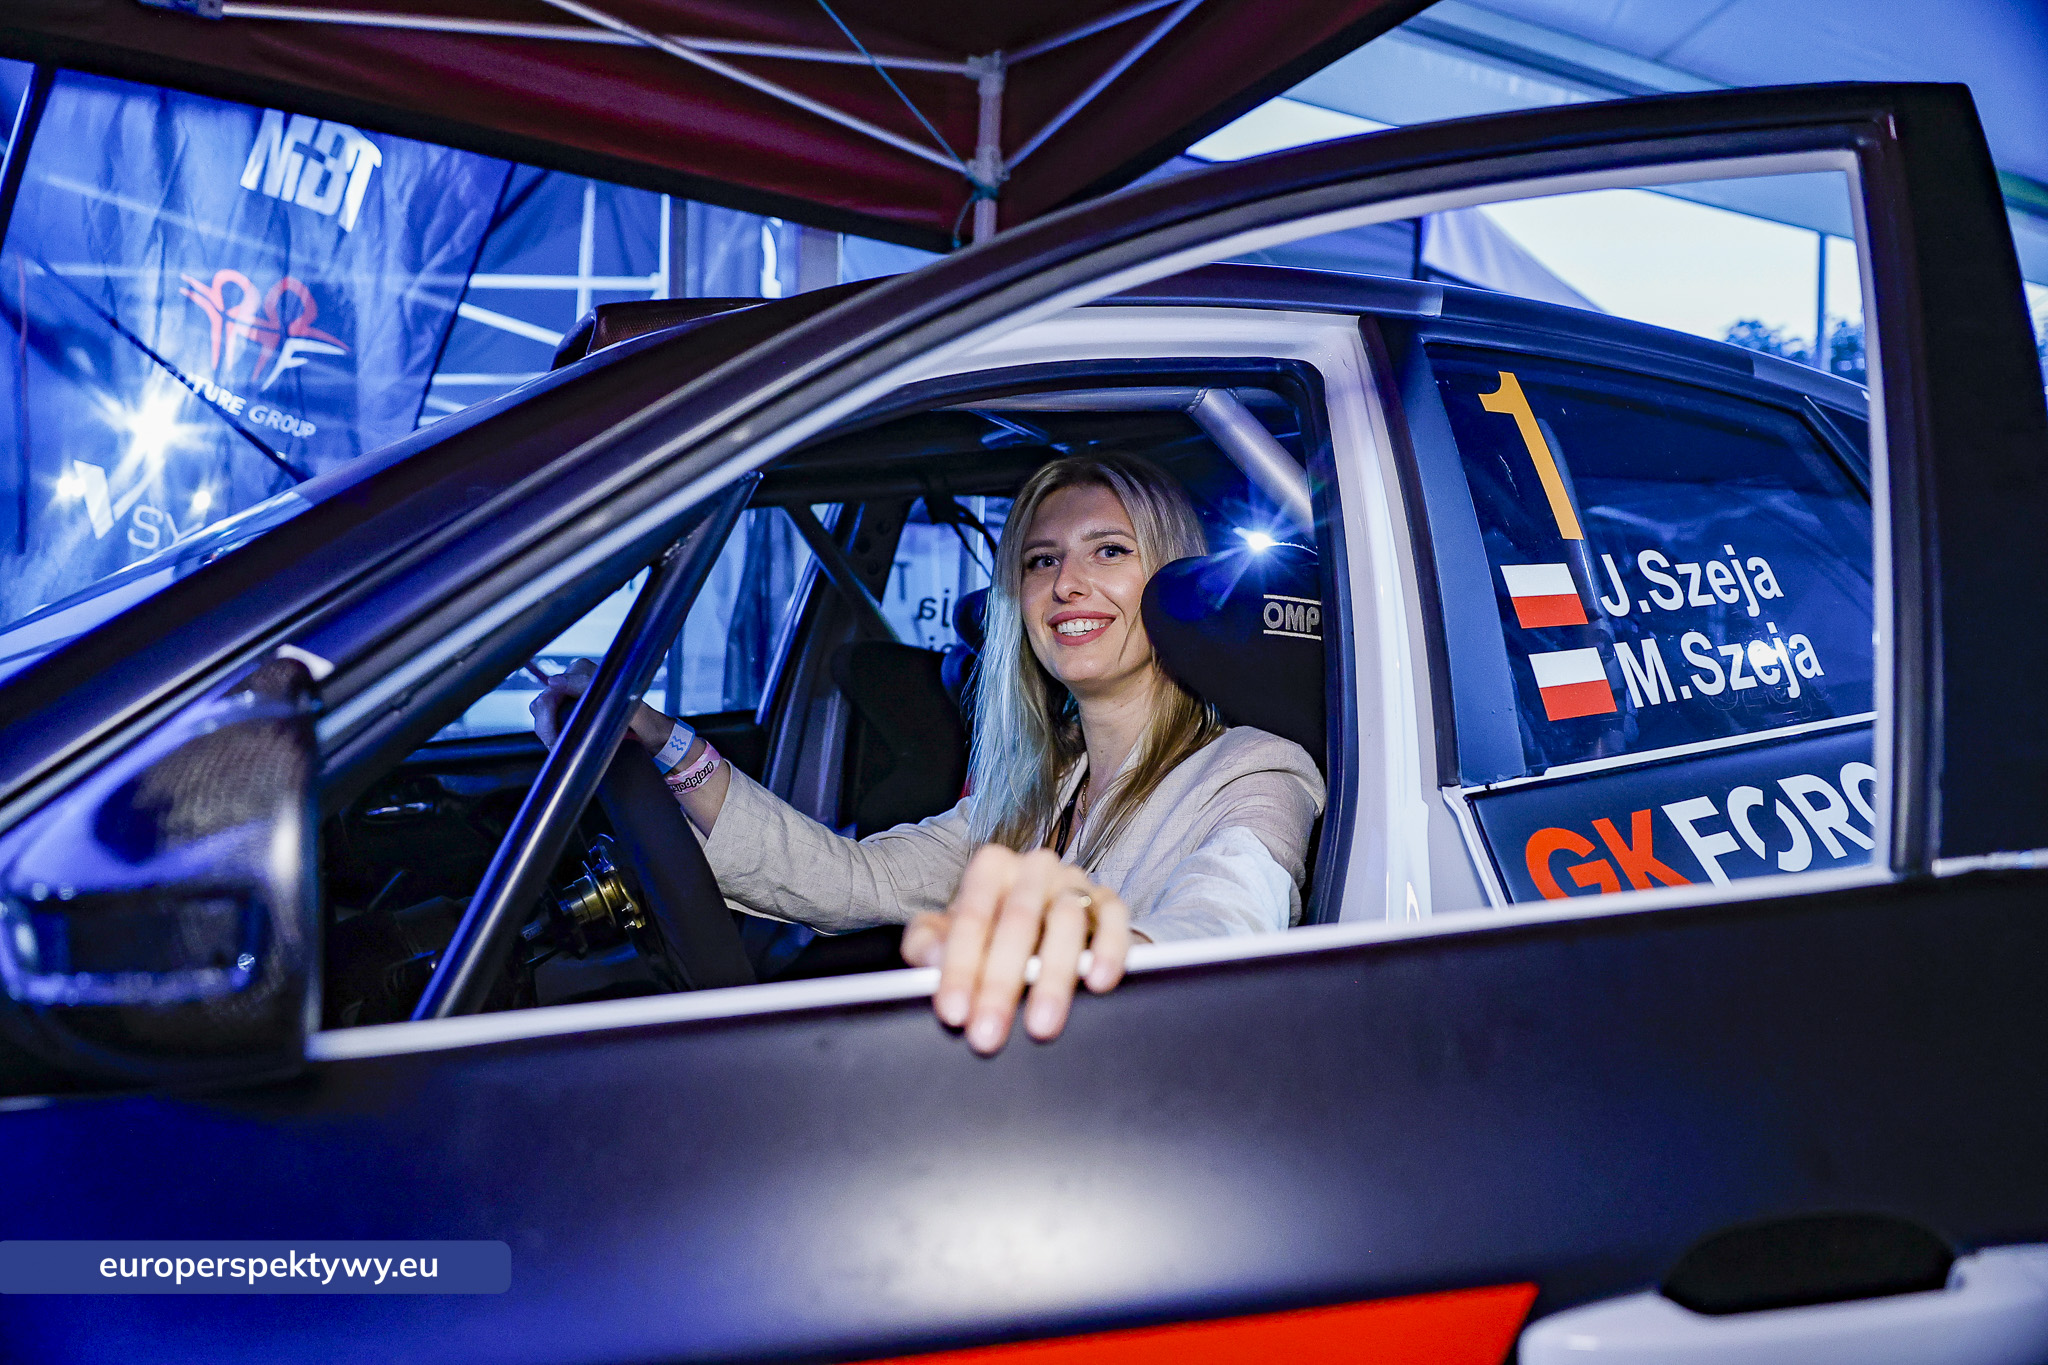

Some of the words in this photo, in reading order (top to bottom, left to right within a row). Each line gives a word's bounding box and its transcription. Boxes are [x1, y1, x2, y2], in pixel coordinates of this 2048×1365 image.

[186, 372, 247, 416] TURE
[248, 405, 316, 437] GROUP
[1478, 371, 1584, 540] 1
[1263, 601, 1320, 632] OMP
[1600, 544, 1784, 618] J.Szeja
[1613, 623, 1825, 709] M.Szeja
